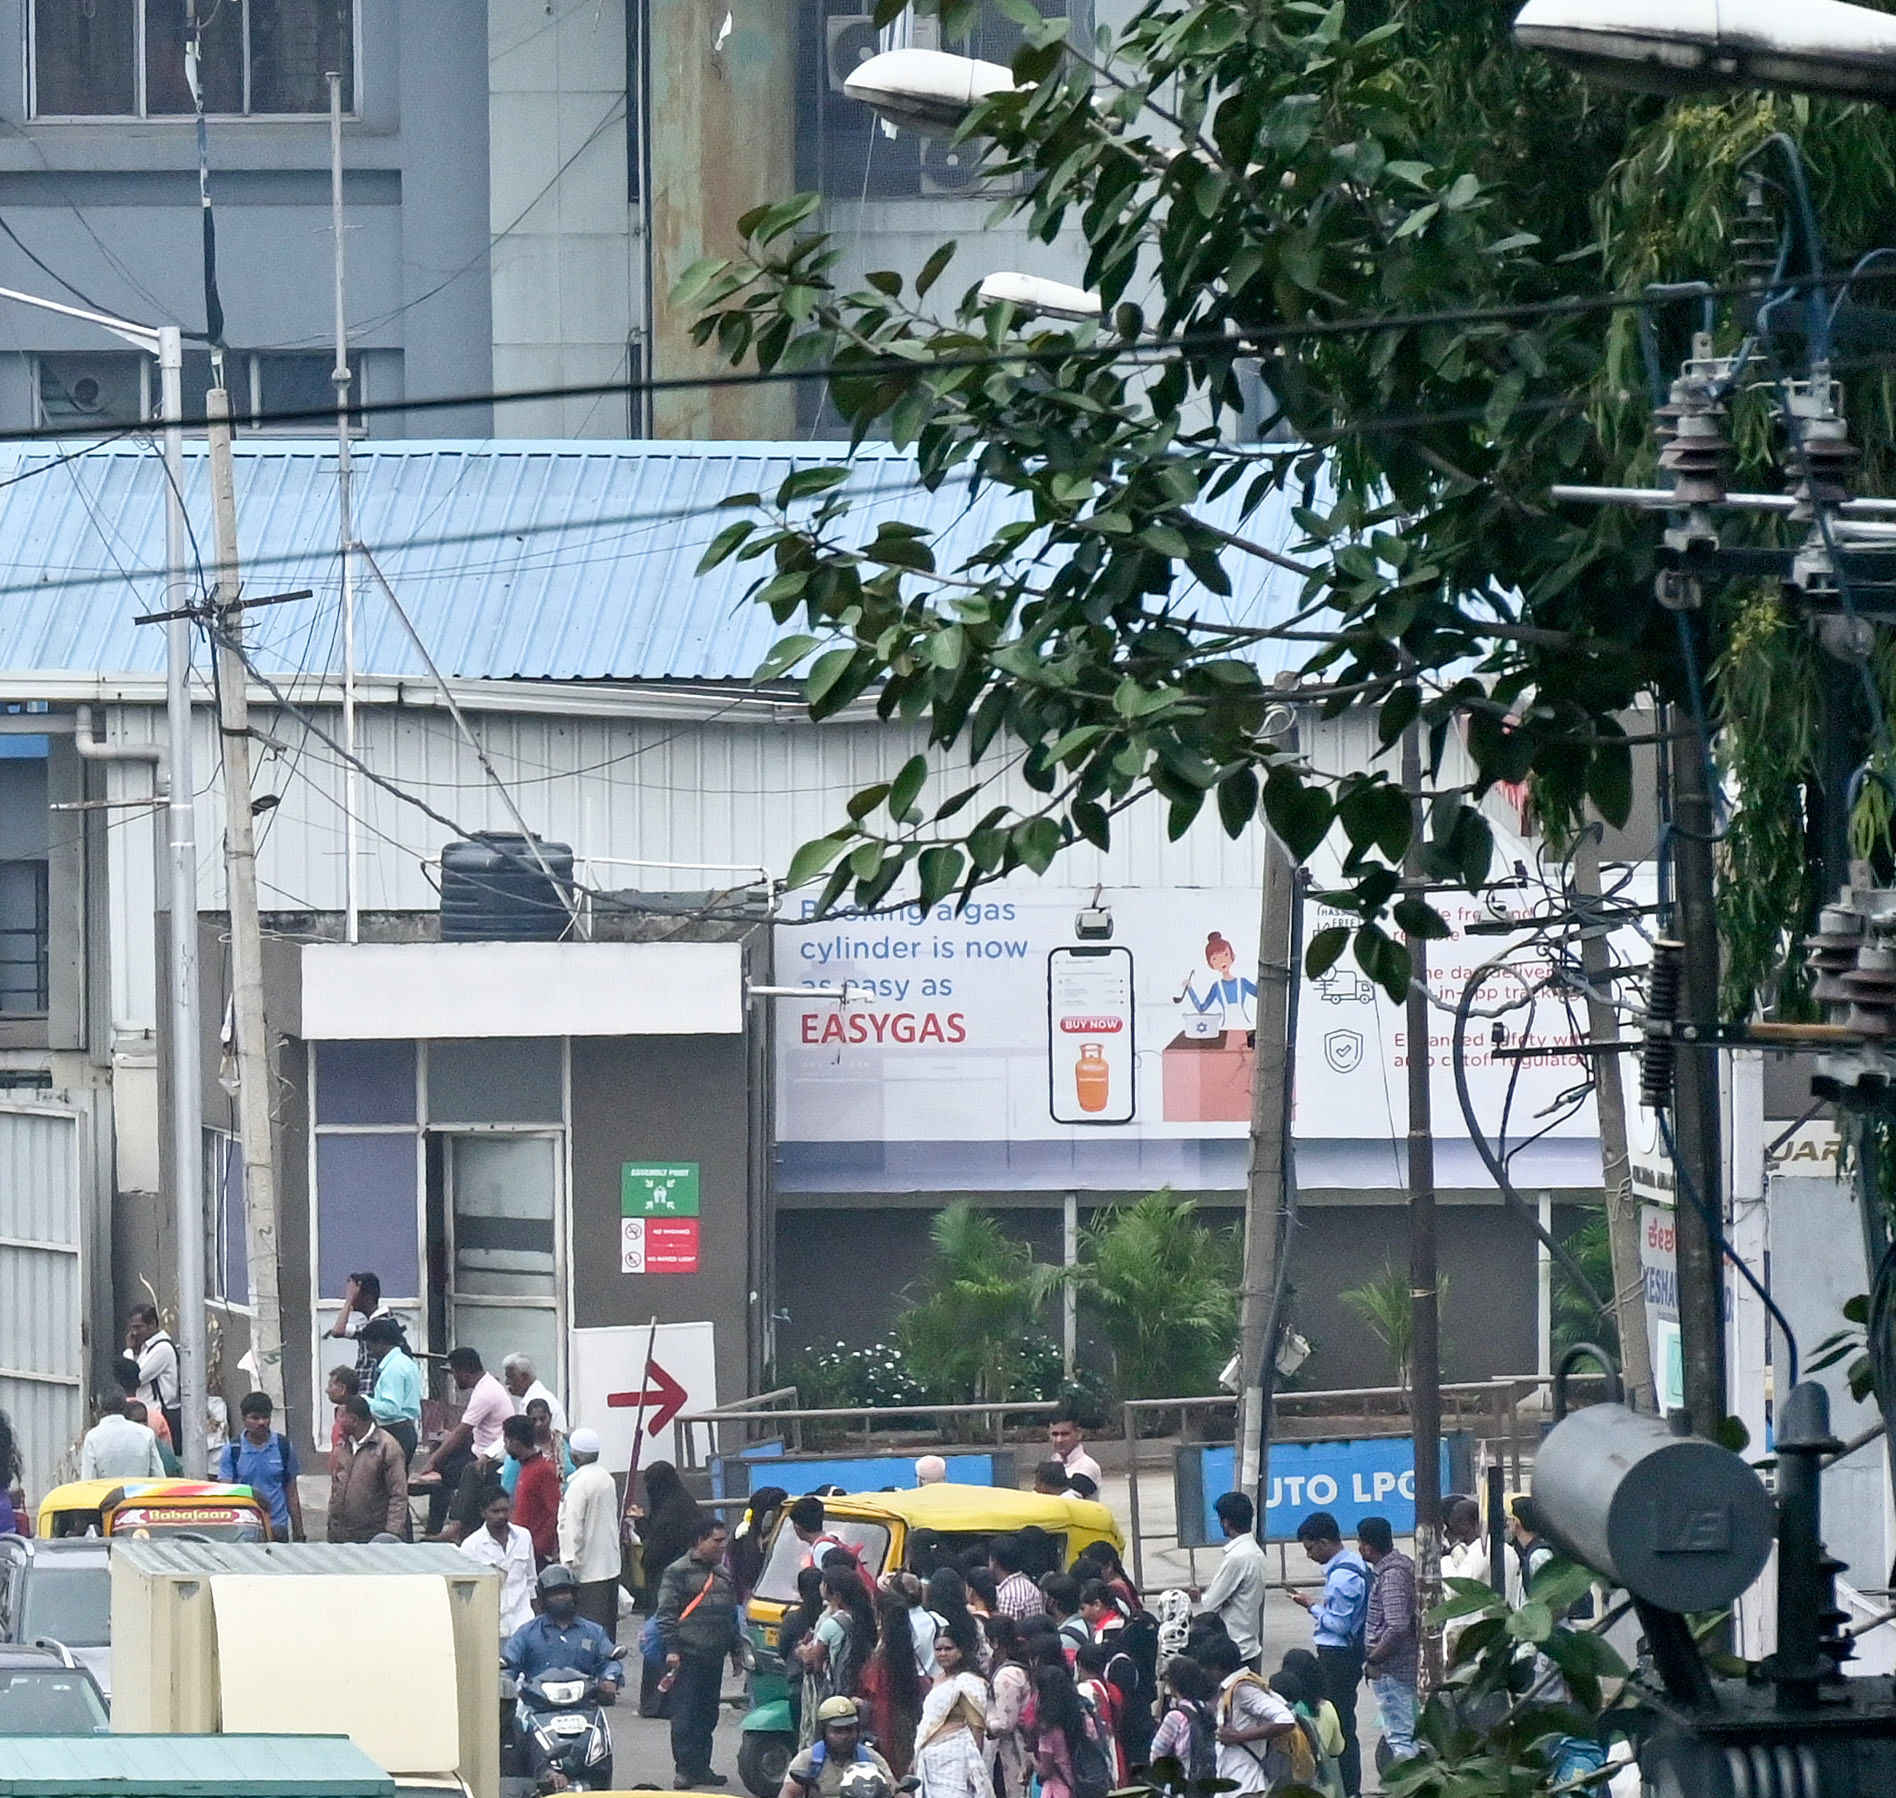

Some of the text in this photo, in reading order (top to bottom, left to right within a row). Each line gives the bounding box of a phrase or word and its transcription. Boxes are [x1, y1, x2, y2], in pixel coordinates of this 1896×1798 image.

[801, 898, 1016, 929] Booking a gas
[801, 934, 1027, 963] cylinder is now
[842, 977, 909, 1005] easy
[918, 977, 953, 1000] as
[800, 1012, 967, 1044] EASYGAS
[1065, 1019, 1119, 1030] BUY NOW
[1265, 1476, 1338, 1508] UTO
[149, 1508, 232, 1523] Babajaan
